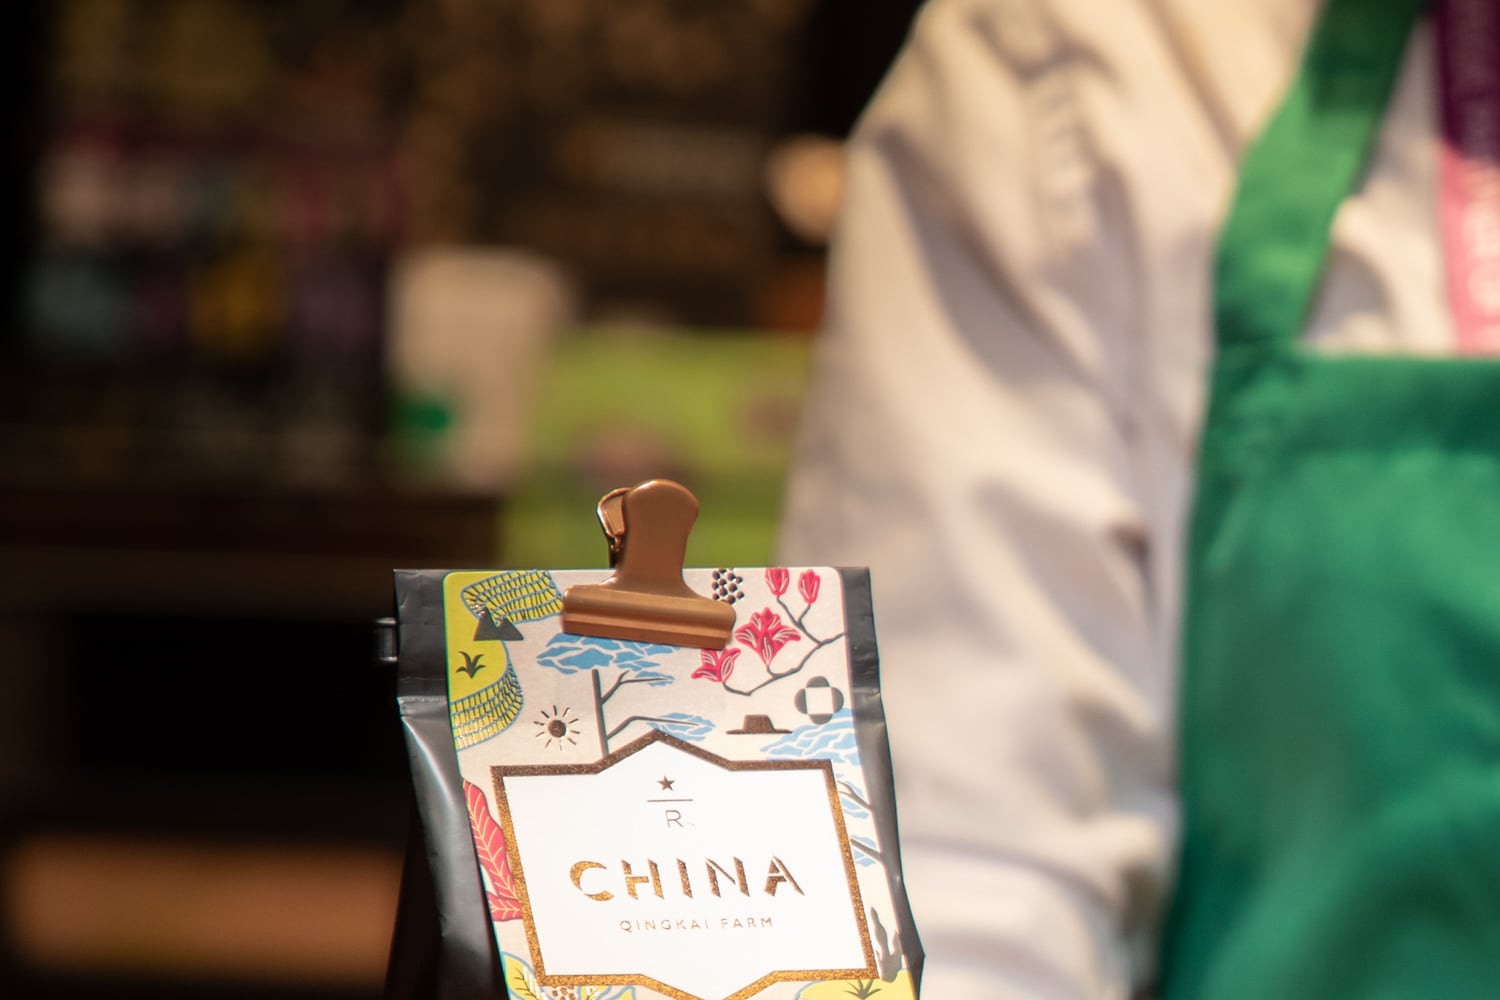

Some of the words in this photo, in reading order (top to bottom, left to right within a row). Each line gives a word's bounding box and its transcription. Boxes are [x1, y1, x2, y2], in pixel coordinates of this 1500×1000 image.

[664, 809, 684, 829] R
[569, 855, 806, 902] CHINA
[619, 918, 710, 933] QINGKAI
[720, 916, 774, 930] FARM
